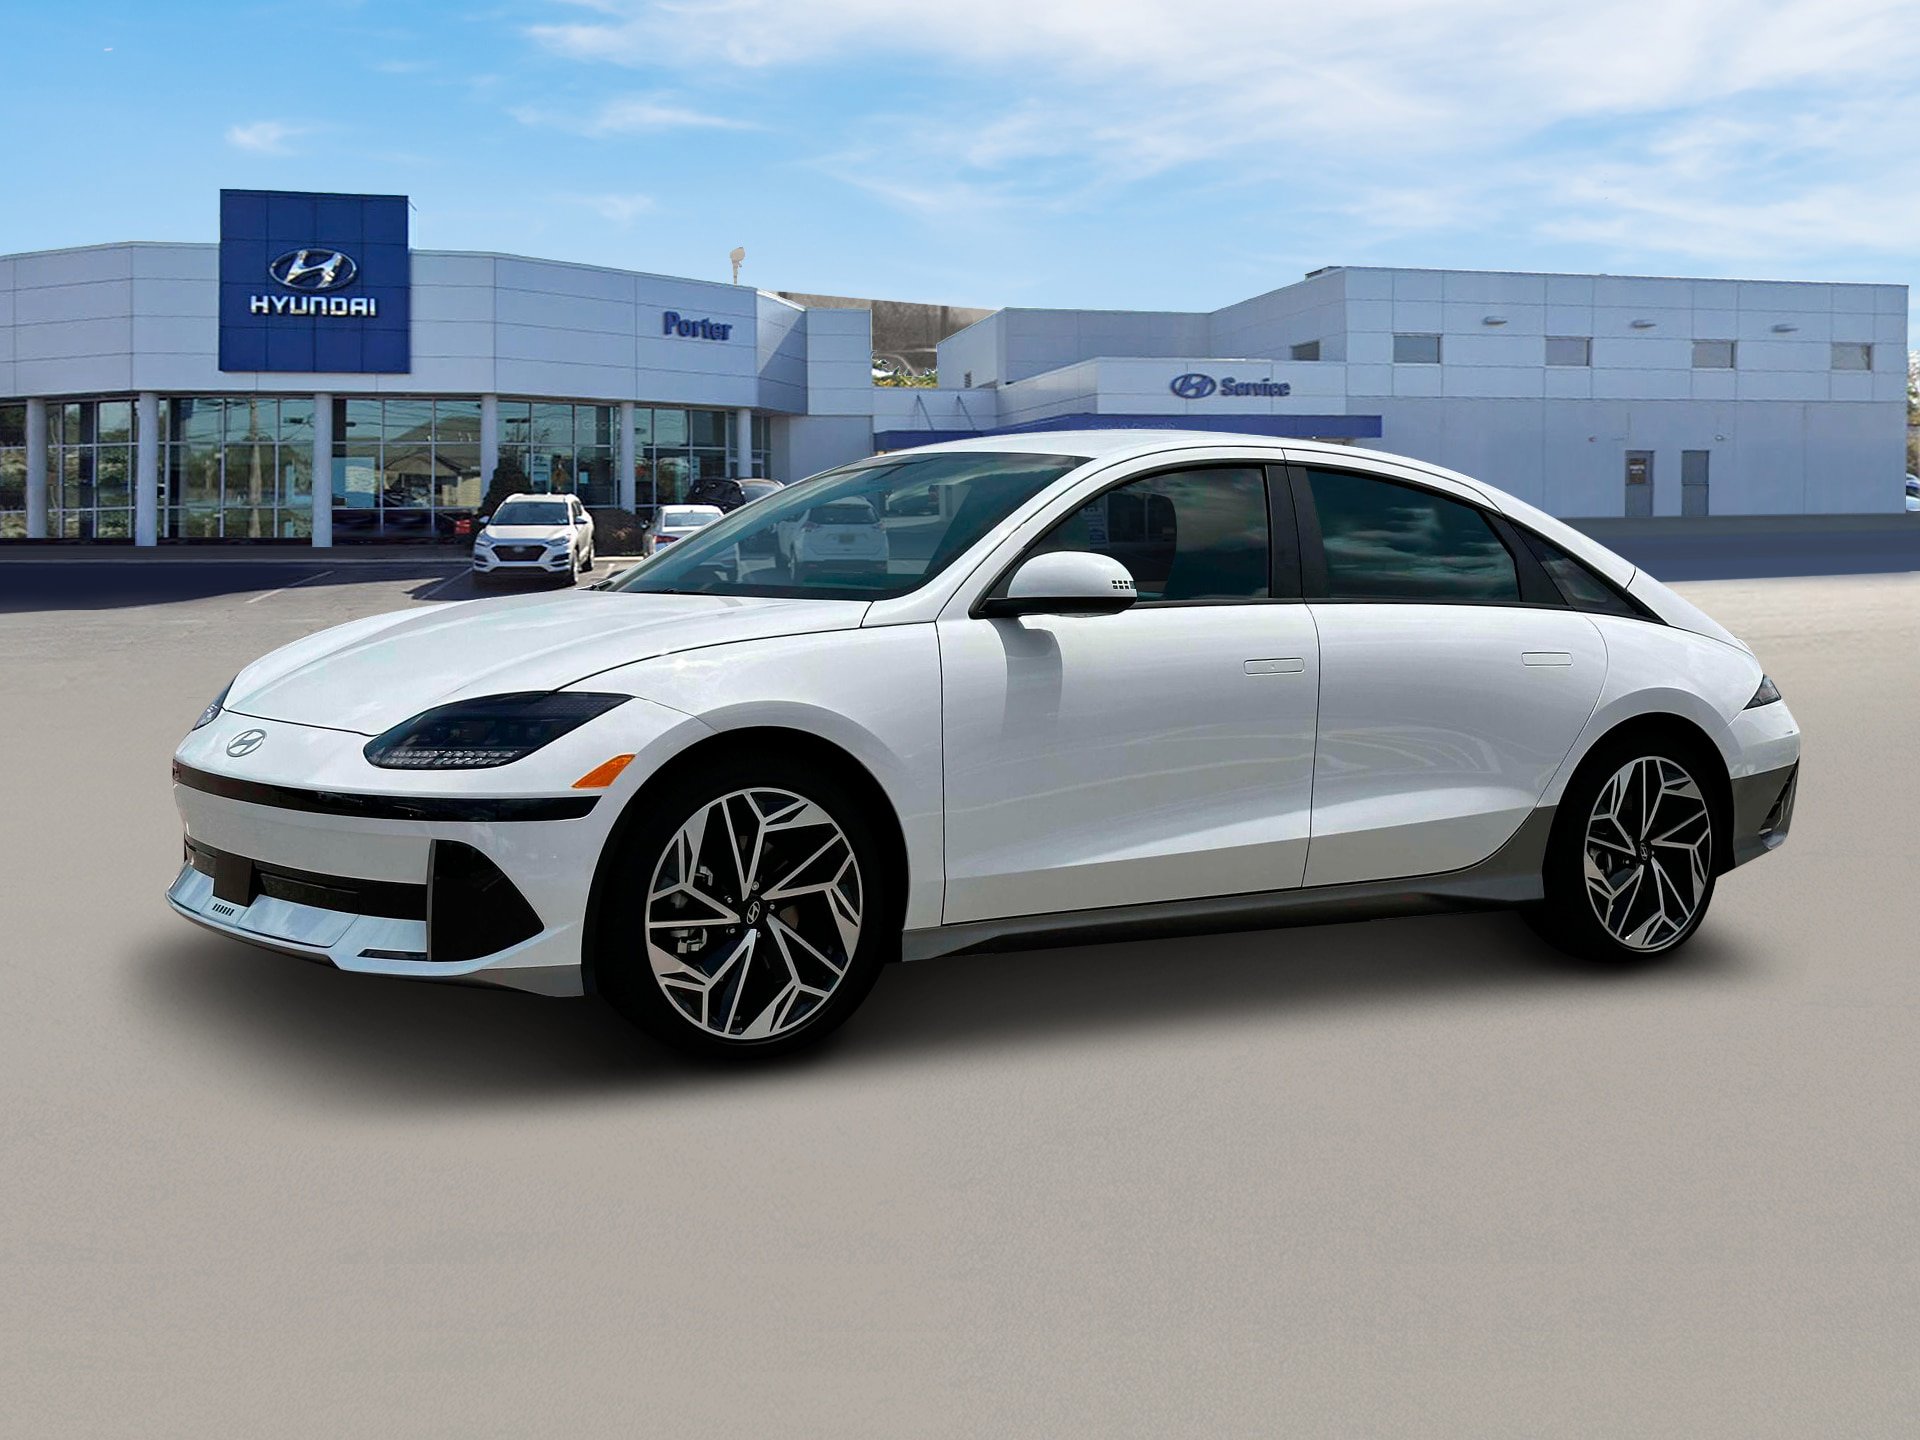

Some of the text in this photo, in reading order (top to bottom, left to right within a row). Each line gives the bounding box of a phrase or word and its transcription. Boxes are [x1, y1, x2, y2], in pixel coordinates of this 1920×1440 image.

[250, 295, 376, 316] HYUNDAI
[663, 311, 733, 341] Porter
[1220, 377, 1291, 397] Service
